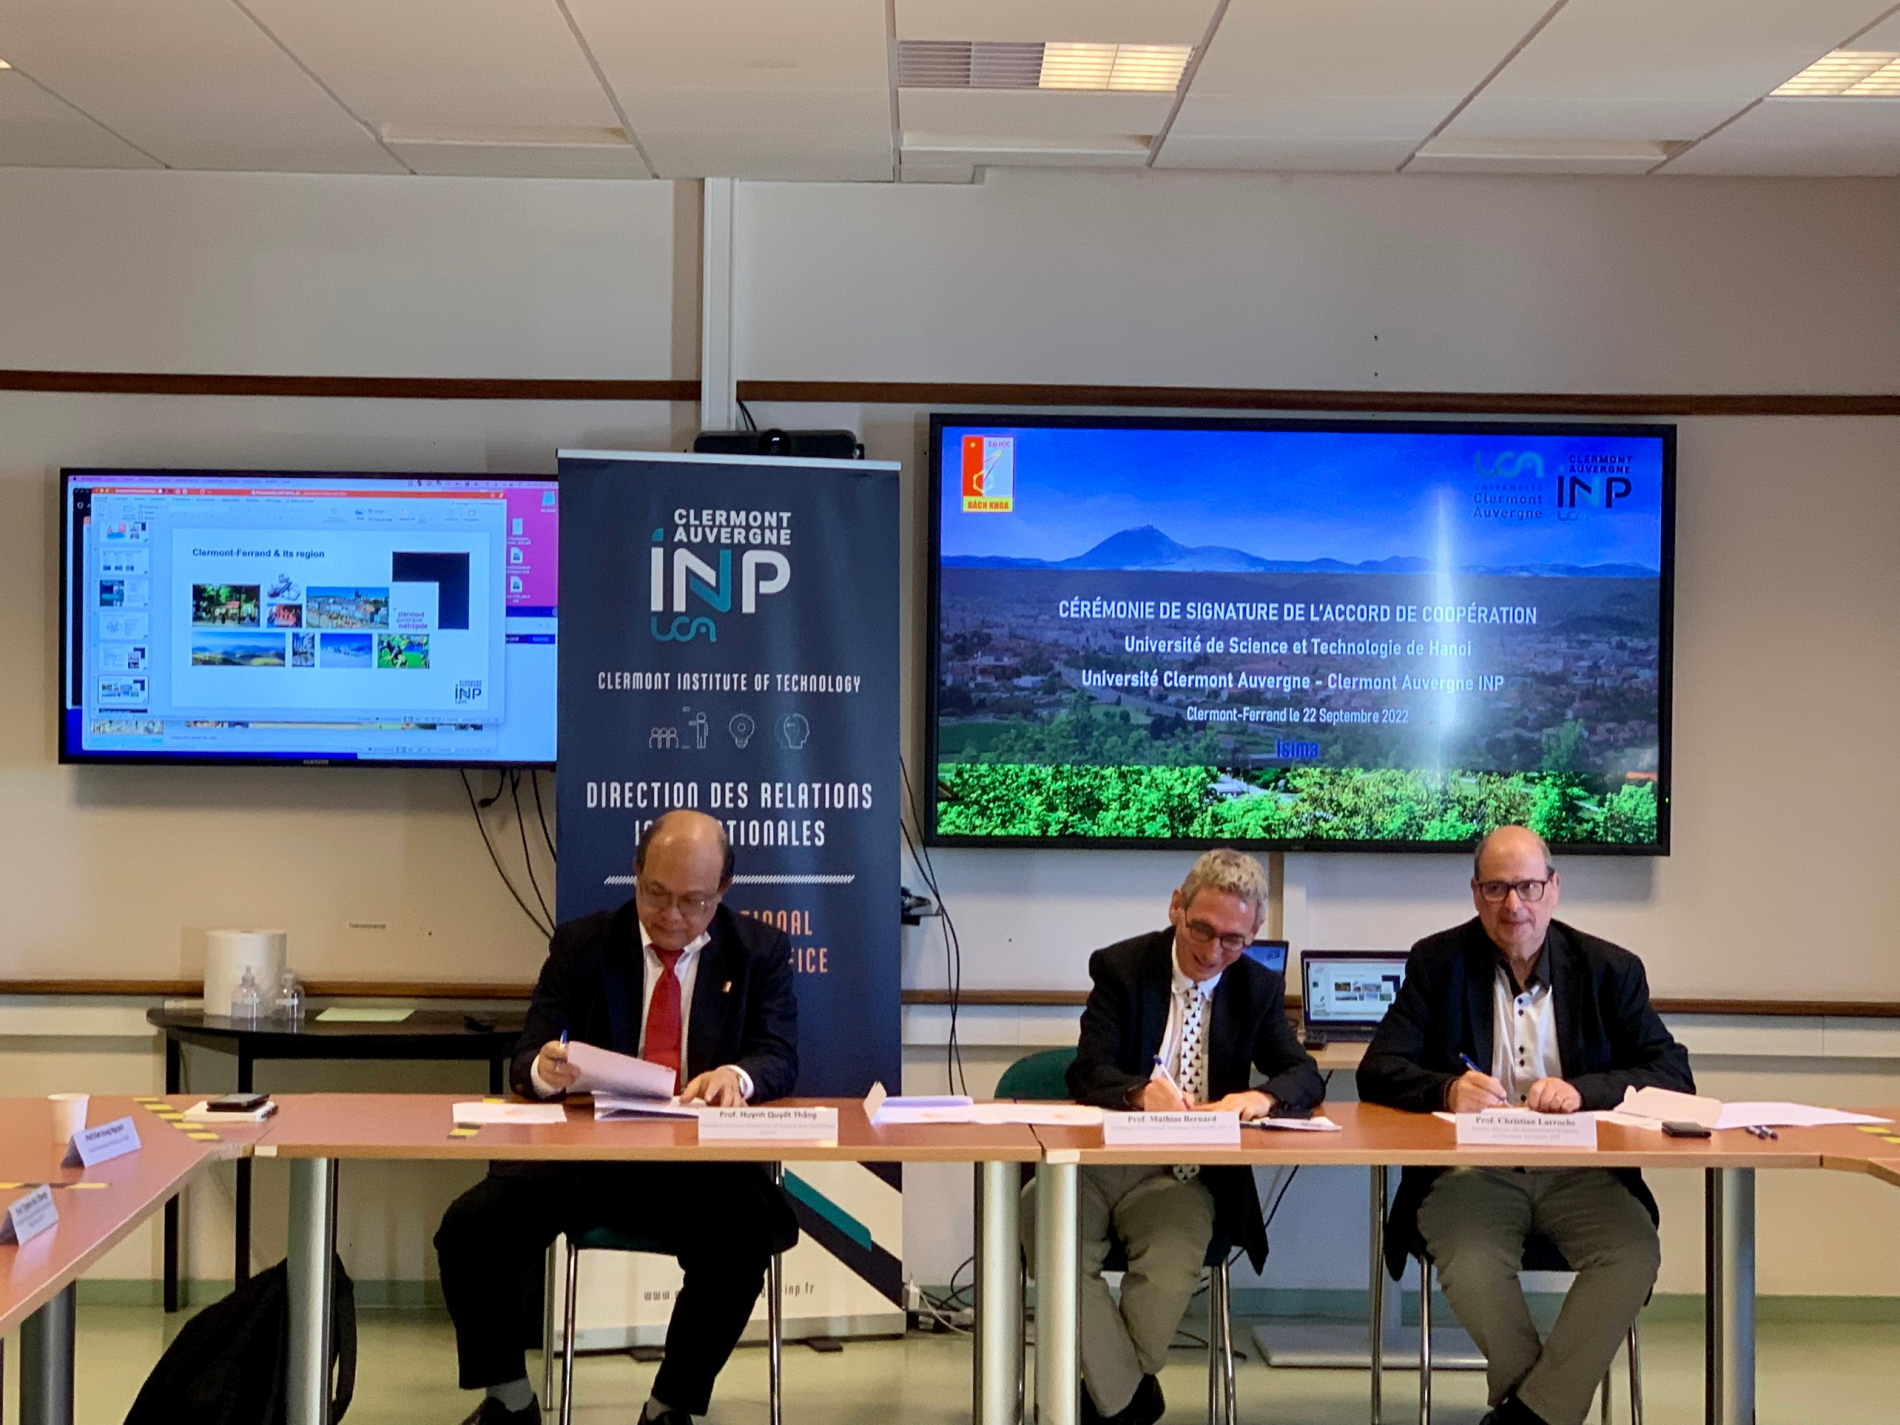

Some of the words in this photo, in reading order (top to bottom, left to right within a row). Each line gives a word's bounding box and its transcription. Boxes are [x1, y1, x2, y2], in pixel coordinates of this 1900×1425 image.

[1569, 454, 1632, 464] CLERMONT
[1569, 465, 1631, 474] AUVERGNE
[1474, 493, 1542, 505] Clermont
[674, 508, 792, 528] CLERMONT
[1474, 507, 1542, 521] Auvergne
[673, 526, 791, 545] AUVERGNE
[192, 547, 271, 558] Clermont-Ferrand
[273, 548, 281, 558] &
[283, 548, 294, 558] its
[296, 549, 325, 560] region
[1058, 596, 1155, 619] CÉRÉMONIE
[1159, 601, 1181, 619] DE
[1186, 601, 1279, 621] SIGNATURE
[1283, 603, 1305, 621] DE
[1396, 605, 1417, 623] DE
[1422, 602, 1537, 624] COOPÉRATION
[1124, 634, 1201, 653] Université
[1206, 636, 1224, 653] de
[1229, 637, 1288, 654] Science
[1293, 638, 1307, 655] et
[1311, 638, 1401, 659] Technologie
[1406, 639, 1424, 656] de
[1429, 639, 1472, 657] Hanoi
[598, 672, 671, 690] CLERMONT
[677, 672, 748, 692] INSTITUTE
[754, 673, 770, 692] OF
[776, 674, 861, 693] TECHNOLOGY
[1082, 668, 1158, 687] Université
[1163, 670, 1233, 689] Clermont
[1238, 671, 1310, 692] Auvergne
[1327, 673, 1397, 690] Clermont
[1402, 674, 1474, 695] Auvergne
[1478, 675, 1505, 692] INP
[1186, 706, 1287, 722] Clermont-Ferrand
[1289, 707, 1300, 723] le
[1303, 707, 1316, 723] 22
[1319, 708, 1380, 726] Septembre
[1382, 709, 1409, 723] 2022
[586, 781, 699, 809] DIRECTION
[710, 781, 749, 809] DES
[760, 782, 873, 809] RELATIONS
[1149, 1115, 1182, 1123] Mathias
[1184, 1115, 1217, 1123] Bernard
[1497, 1116, 1536, 1126] Christian
[1538, 1117, 1576, 1127] Larroche
